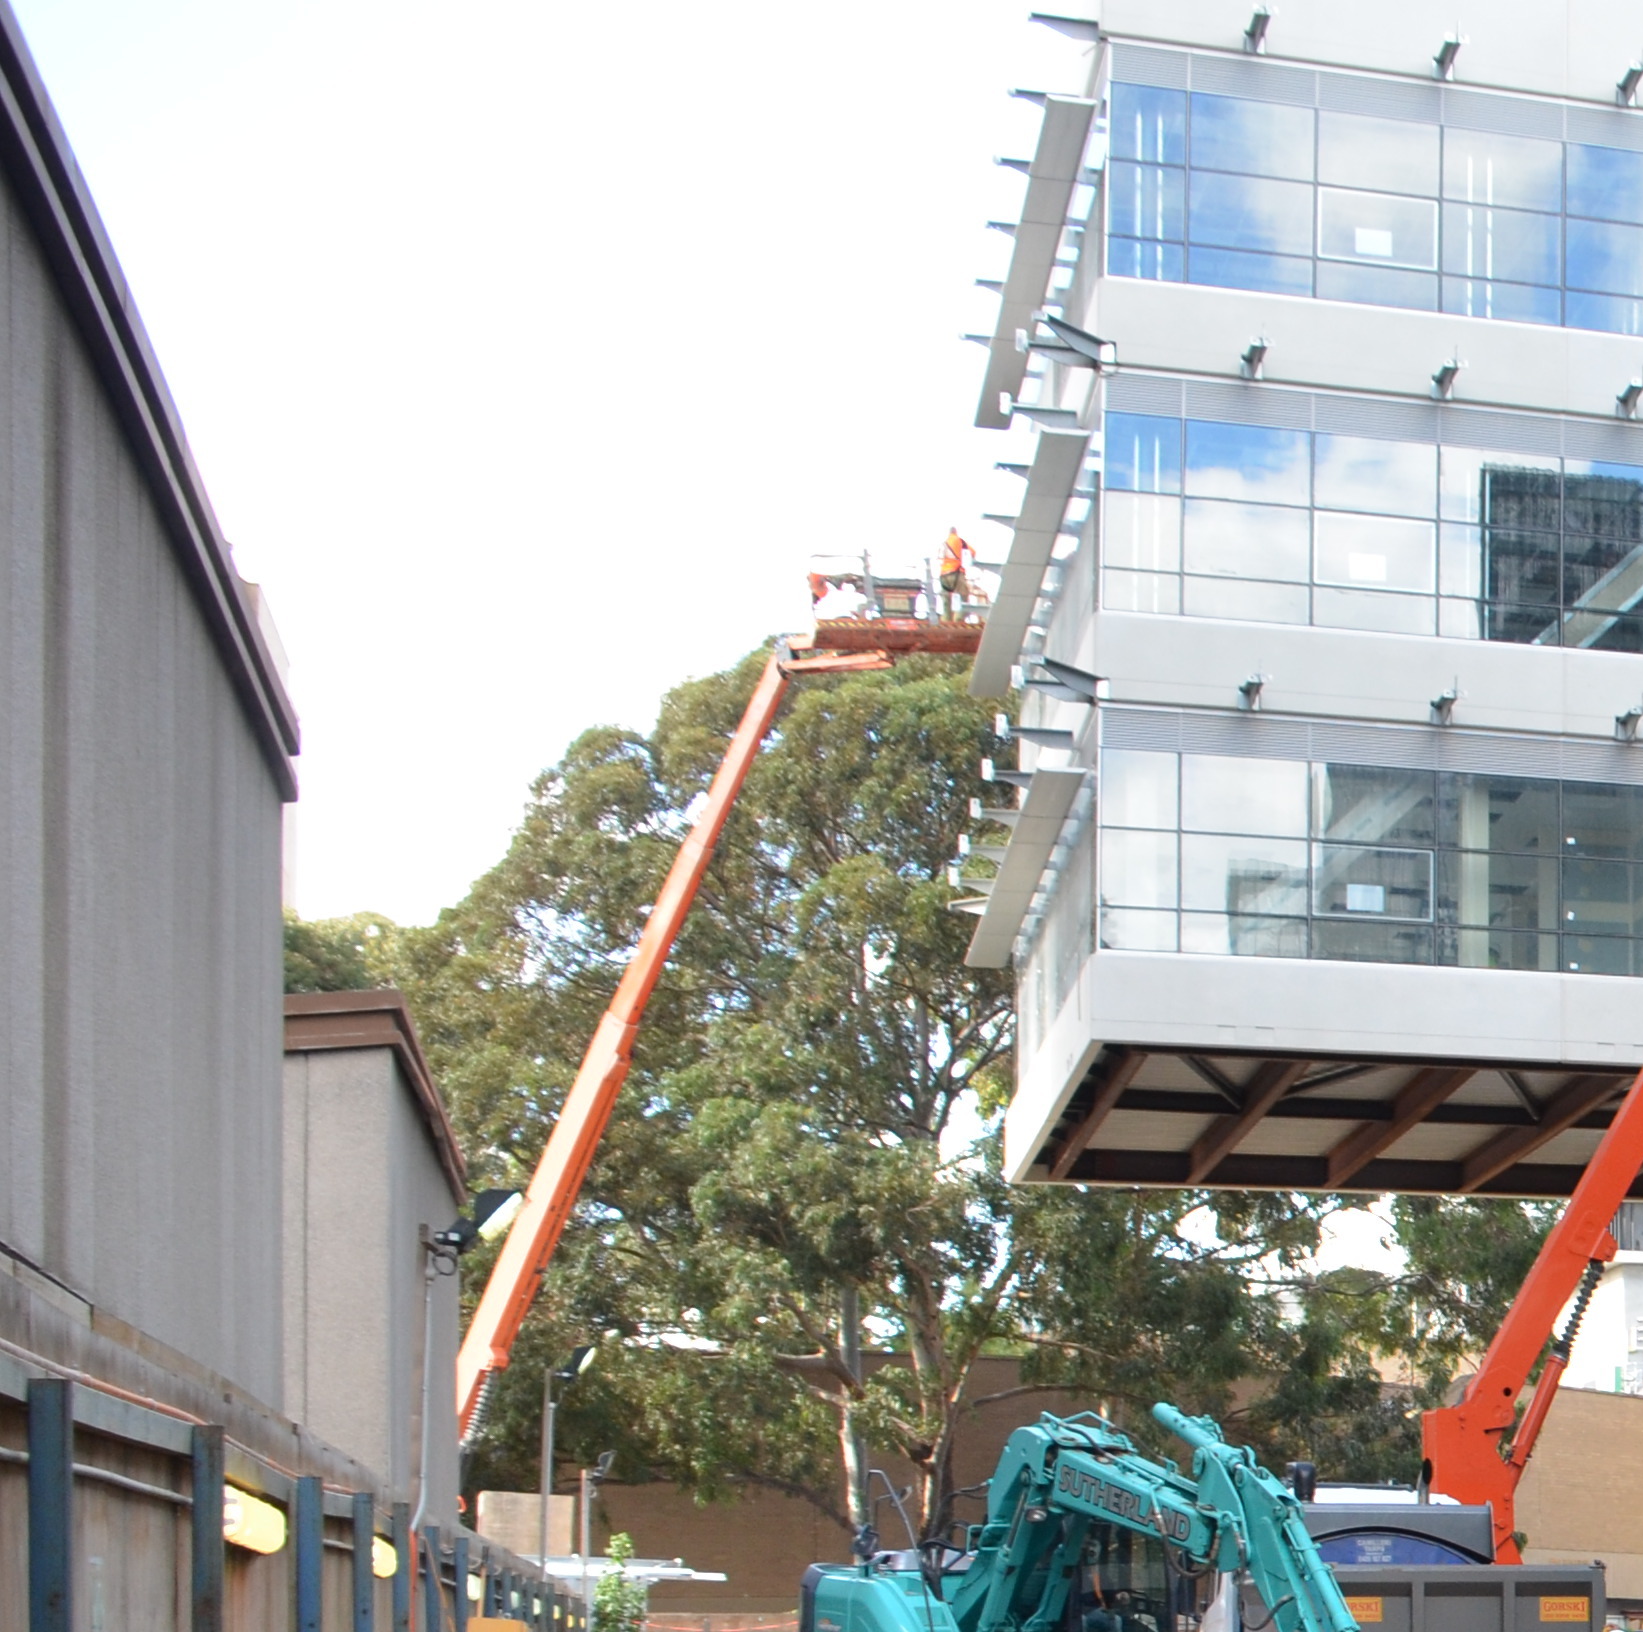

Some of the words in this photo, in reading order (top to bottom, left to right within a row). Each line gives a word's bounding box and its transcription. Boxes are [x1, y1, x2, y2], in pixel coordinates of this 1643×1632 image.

[1058, 1464, 1191, 1542] SUTHERLAND
[1349, 1601, 1380, 1612] RSKI
[1543, 1600, 1586, 1612] GORSKI
